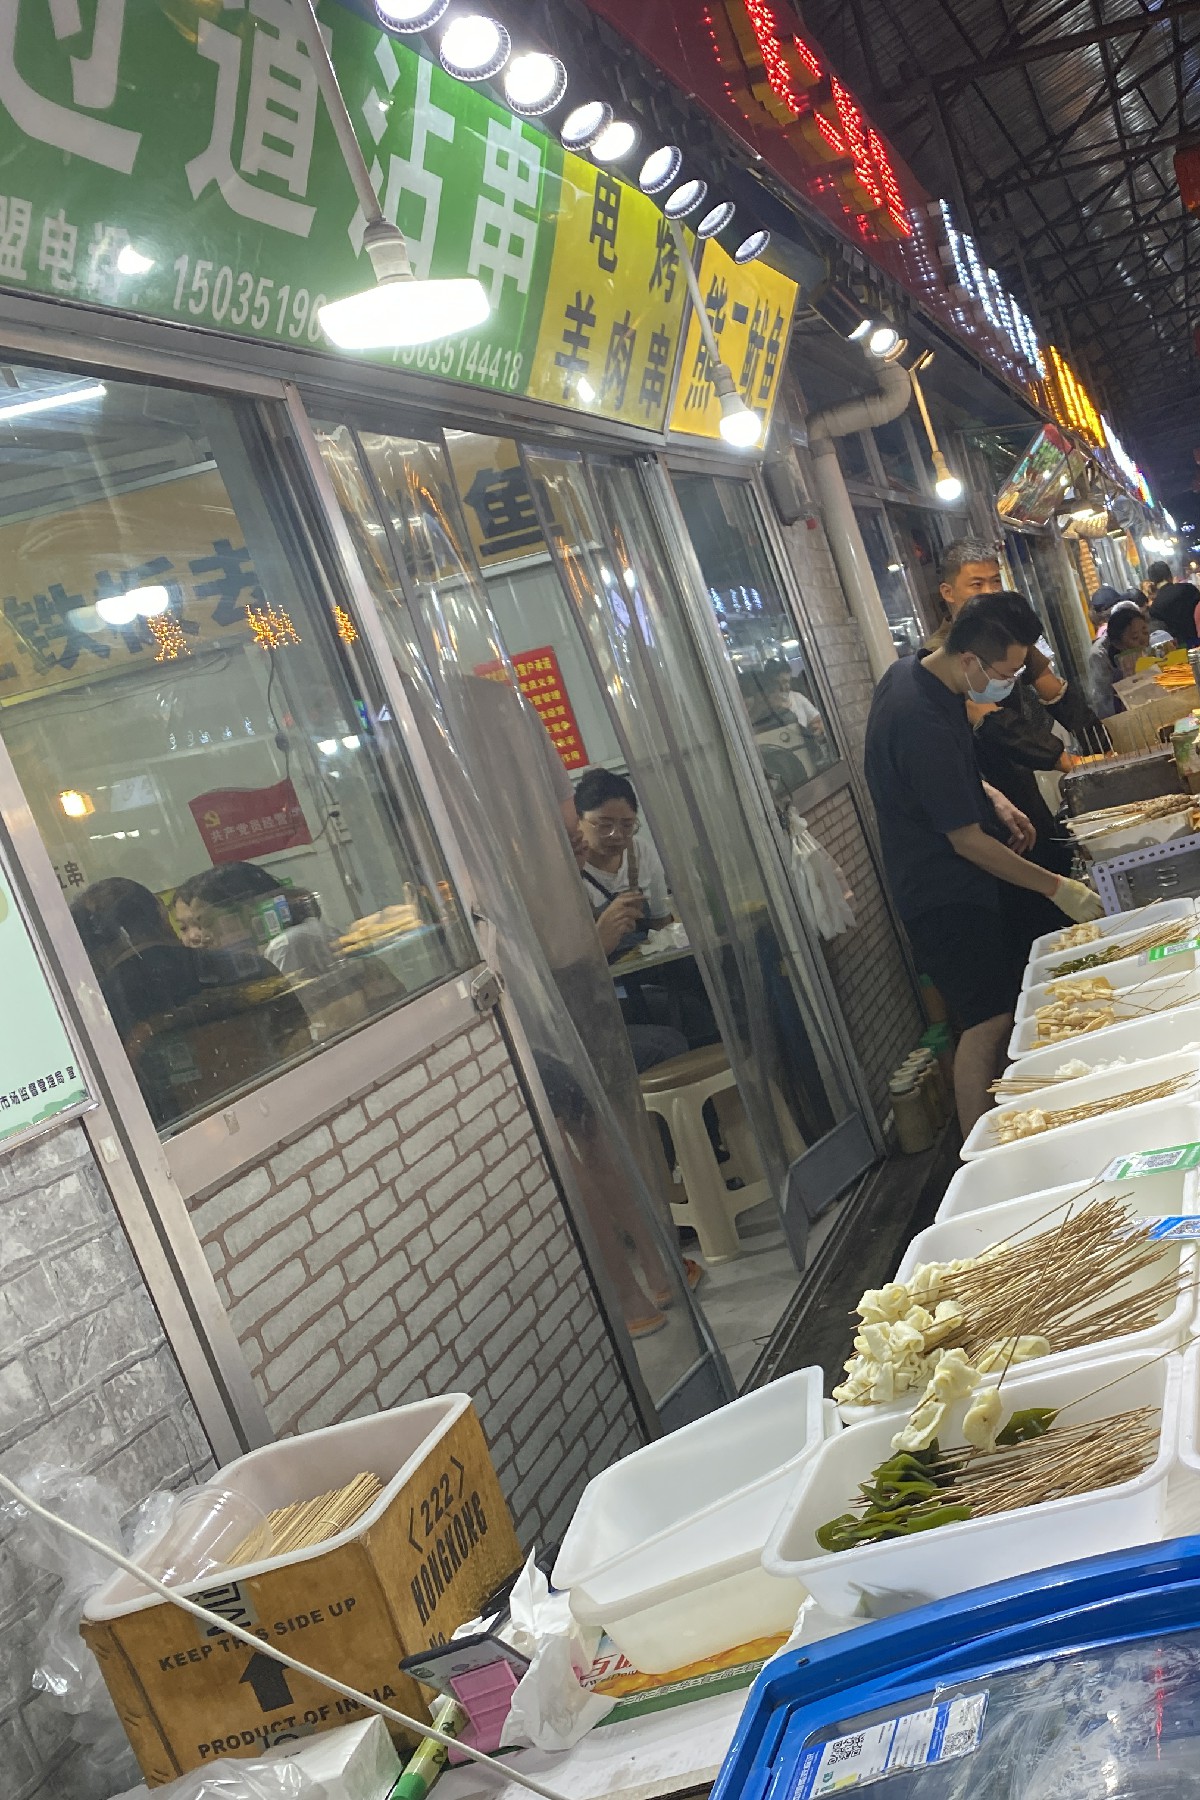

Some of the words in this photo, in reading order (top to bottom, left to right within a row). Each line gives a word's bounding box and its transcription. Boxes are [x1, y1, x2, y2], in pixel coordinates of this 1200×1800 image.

[554, 291, 671, 418] 羊肉串
[410, 1490, 488, 1627] HONGKONG
[159, 1644, 212, 1672] KEEP
[274, 1609, 325, 1635] SIDE
[328, 1597, 357, 1617] UP
[303, 1704, 331, 1725] OF
[336, 1685, 396, 1714] INIA
